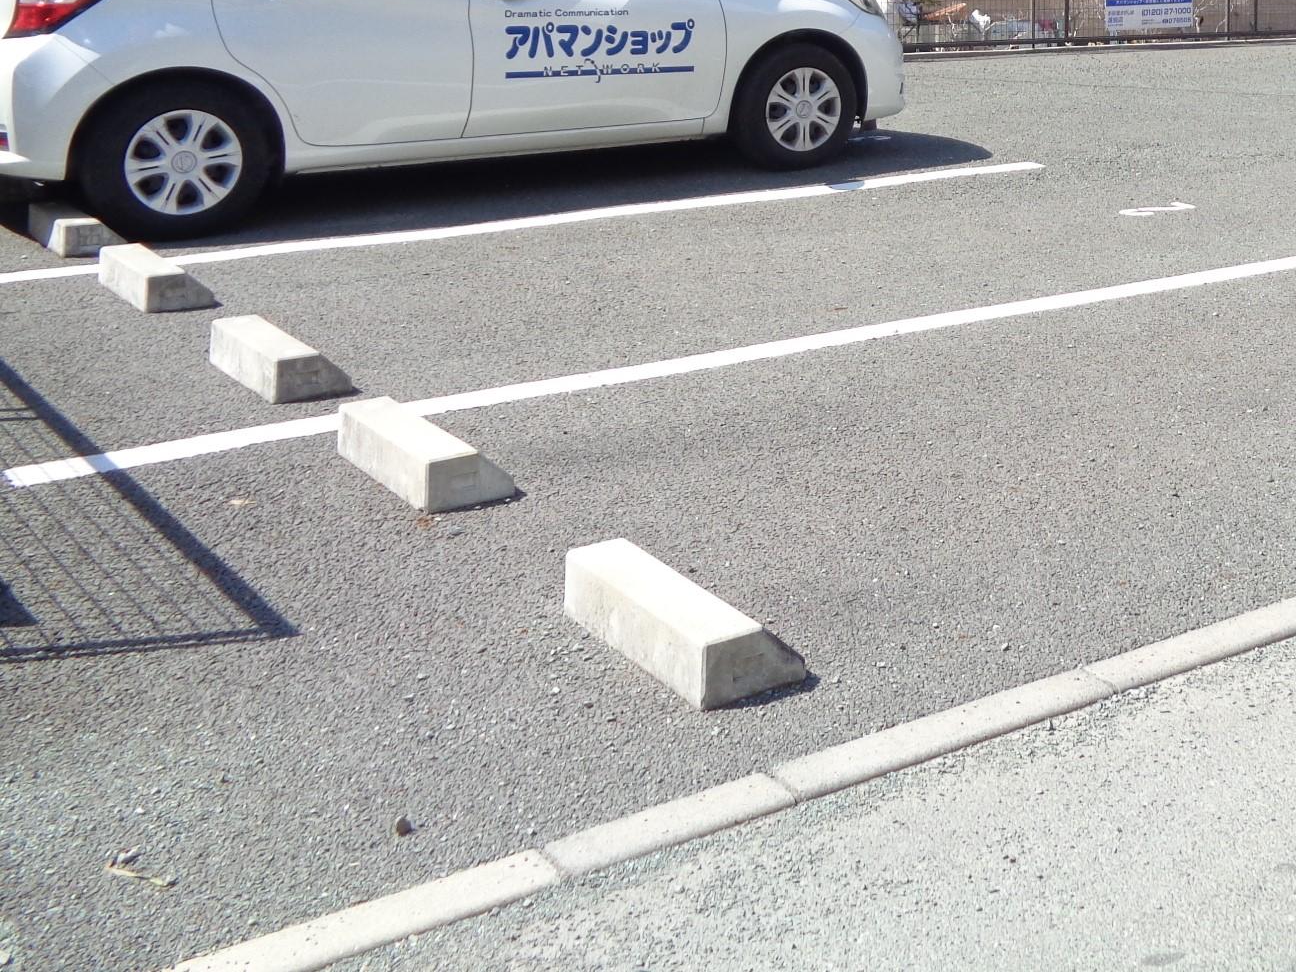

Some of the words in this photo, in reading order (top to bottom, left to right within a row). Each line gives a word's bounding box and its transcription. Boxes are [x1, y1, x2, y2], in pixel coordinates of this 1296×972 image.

[504, 8, 552, 18] Dramatic
[554, 7, 629, 17] Communication
[505, 18, 695, 59] アパマンショップ
